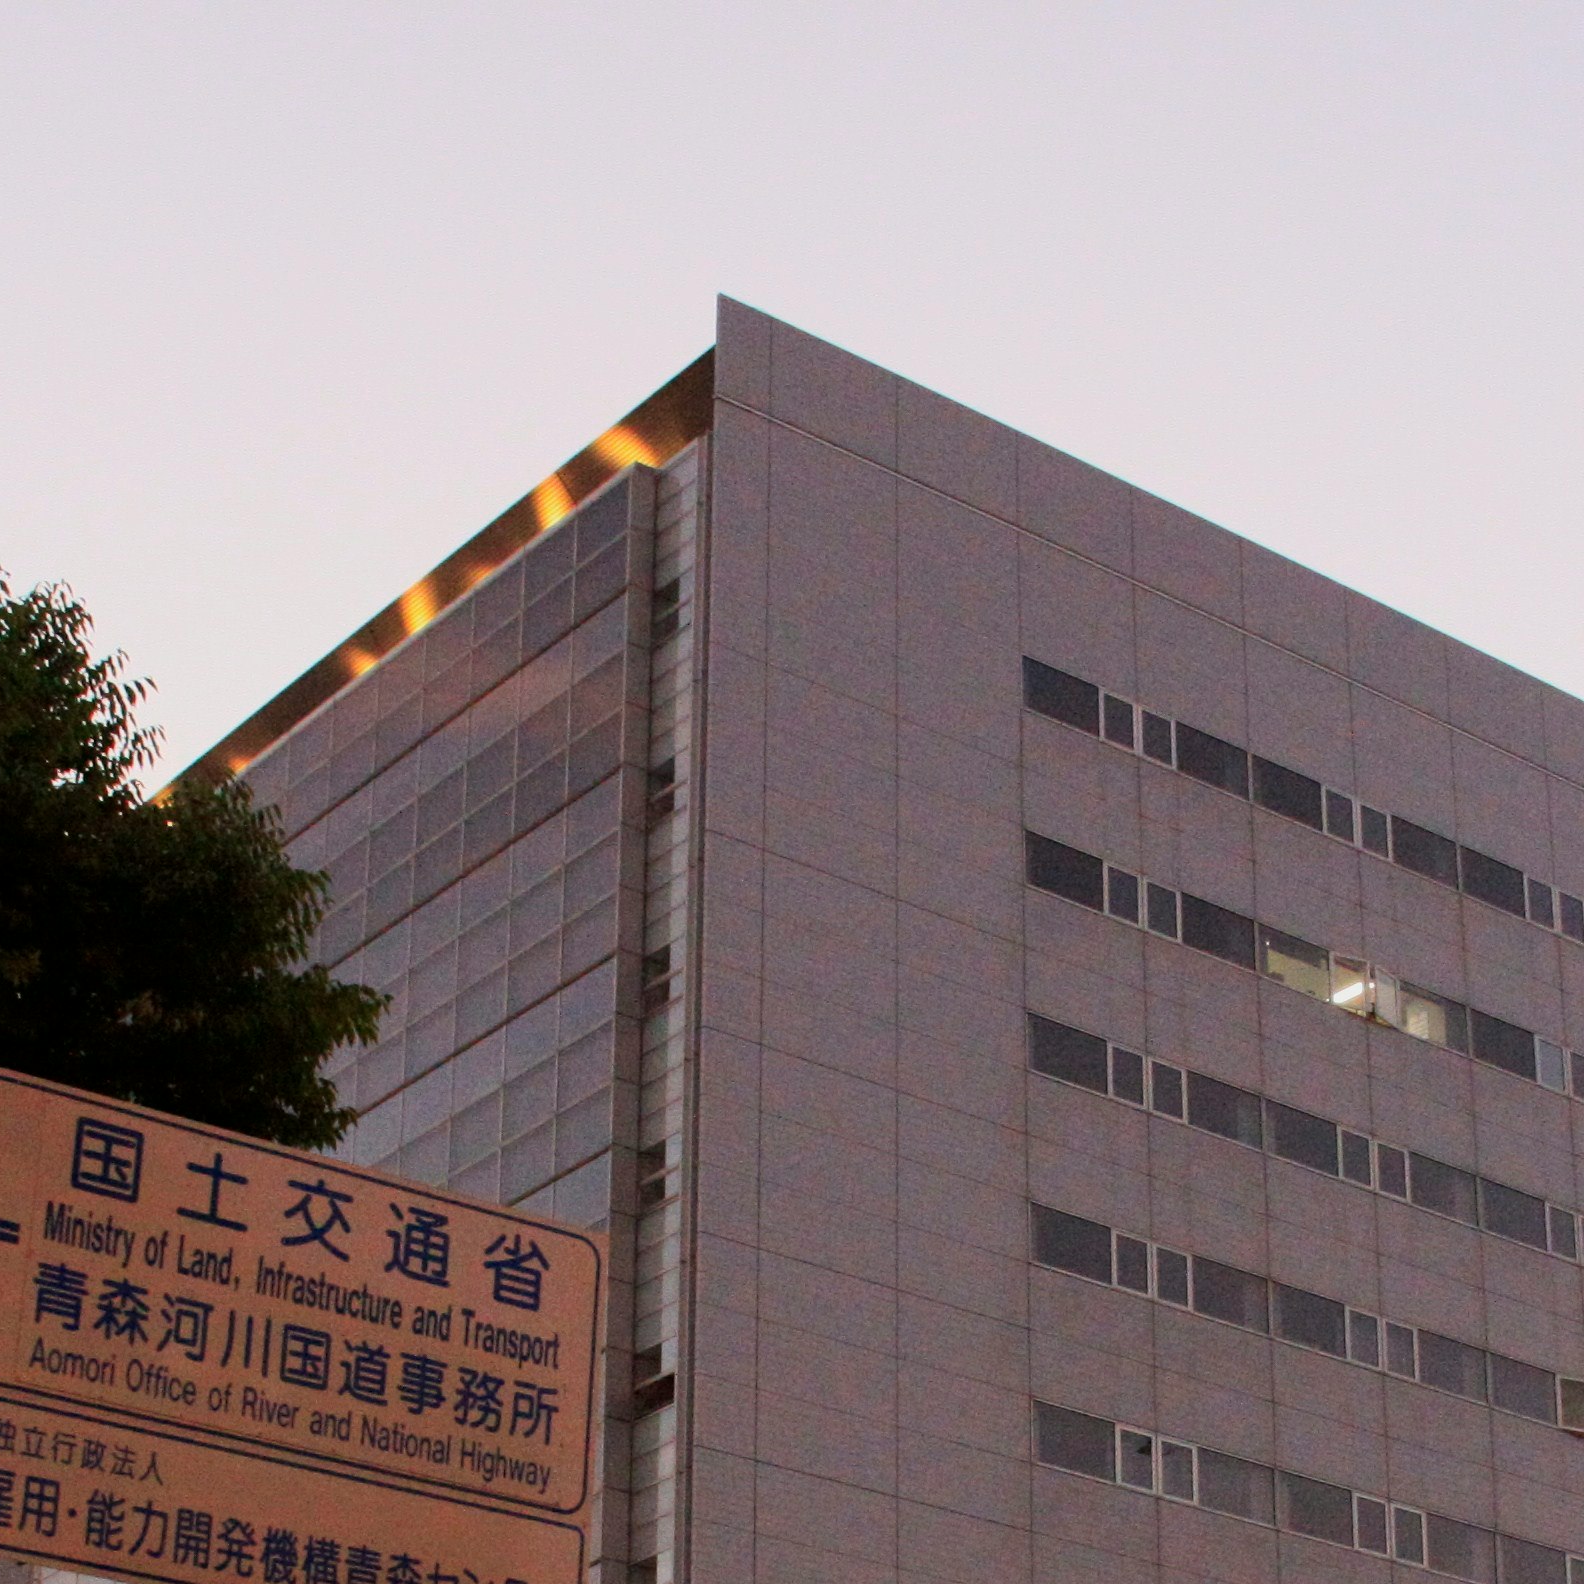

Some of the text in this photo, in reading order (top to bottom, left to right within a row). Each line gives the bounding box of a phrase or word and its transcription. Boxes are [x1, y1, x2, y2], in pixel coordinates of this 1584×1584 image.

[45, 1201, 561, 1370] Ministry of Land, Infrastructure and Transport
[71, 1116, 550, 1312] 国土交通省
[29, 1338, 552, 1491] Aomori Office of River and National Highway
[33, 1260, 560, 1447] 青森河川国道事務所
